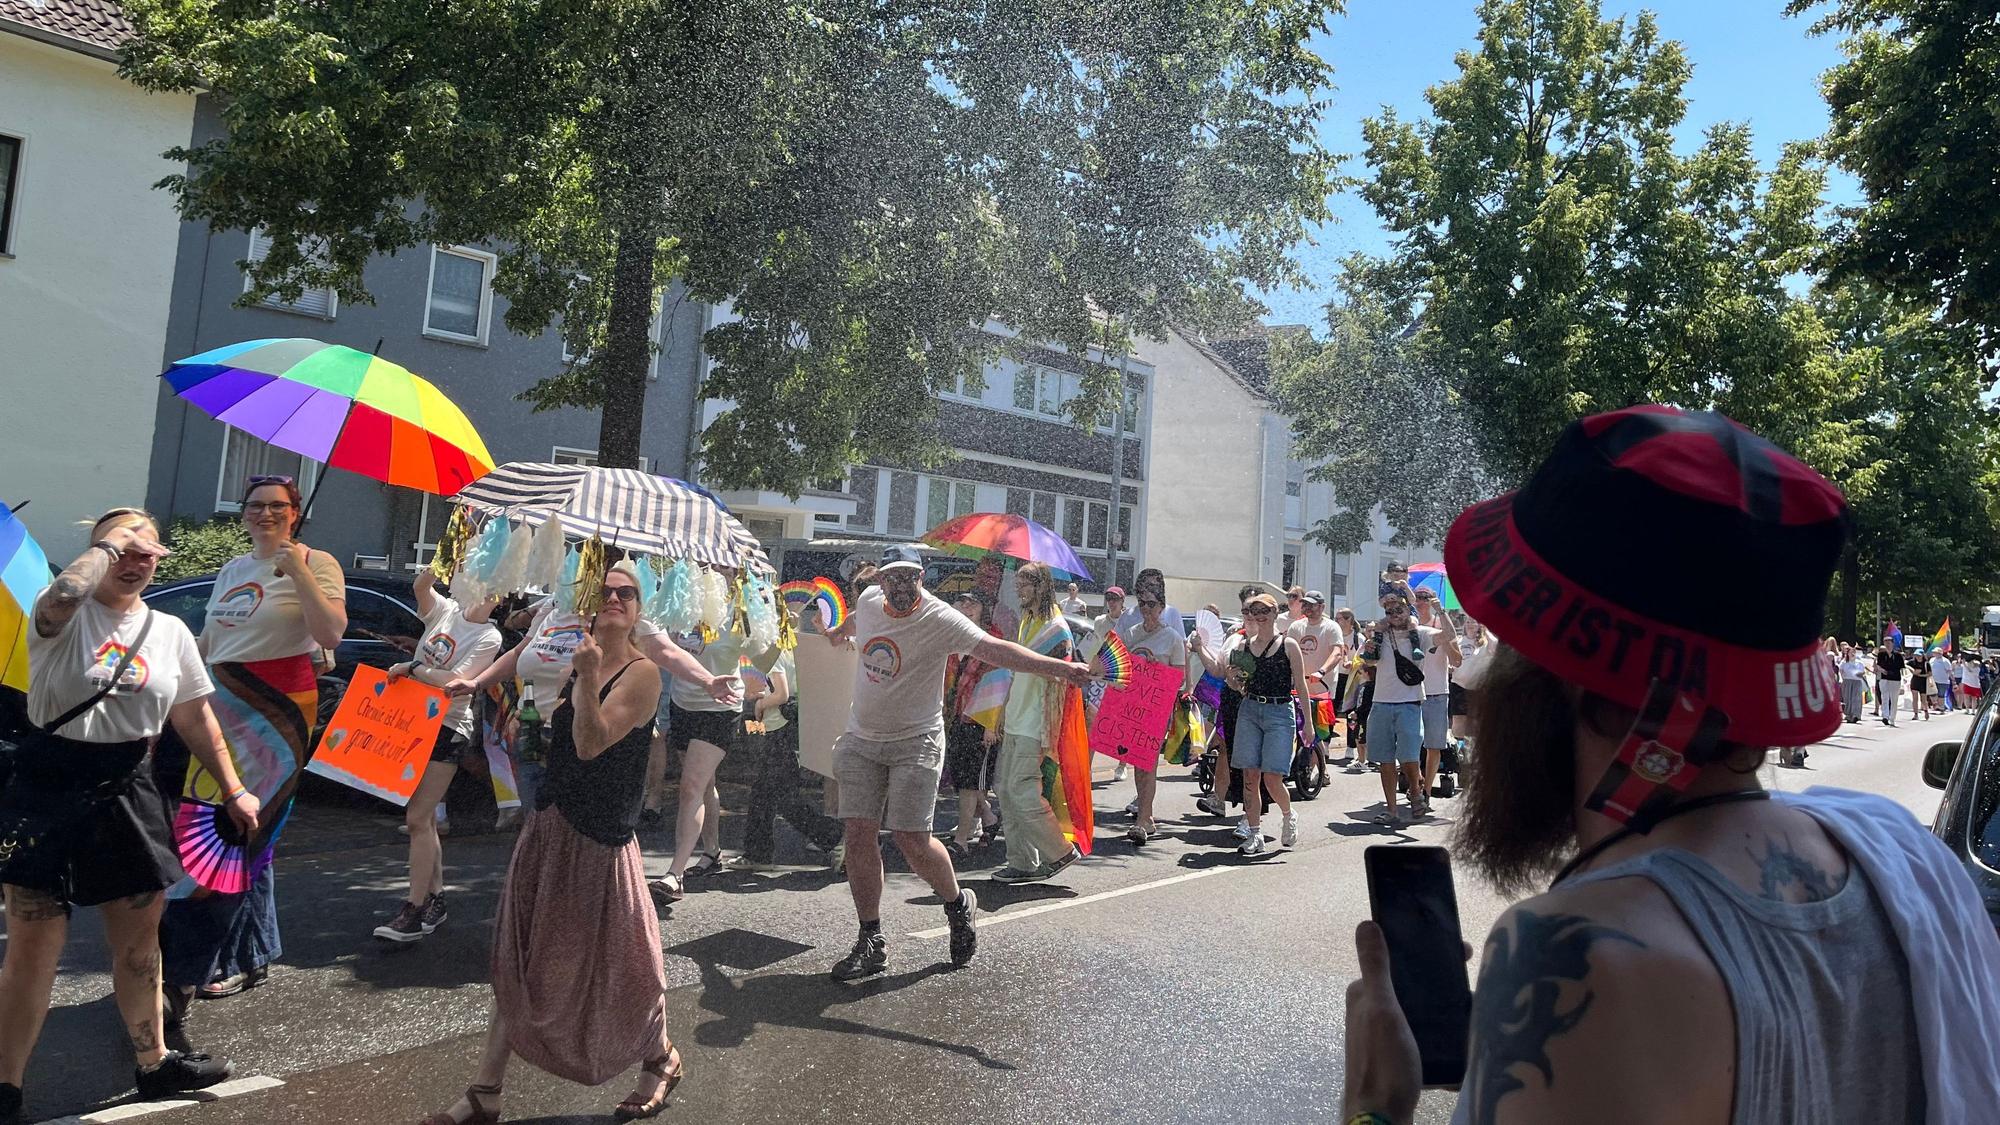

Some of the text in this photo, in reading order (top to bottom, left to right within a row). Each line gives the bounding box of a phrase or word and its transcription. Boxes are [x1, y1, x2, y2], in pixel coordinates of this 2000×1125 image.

[1550, 596, 1647, 673] IST
[1647, 633, 1708, 692] DA
[1131, 661, 1161, 681] AKE
[1122, 703, 1152, 721] NOT
